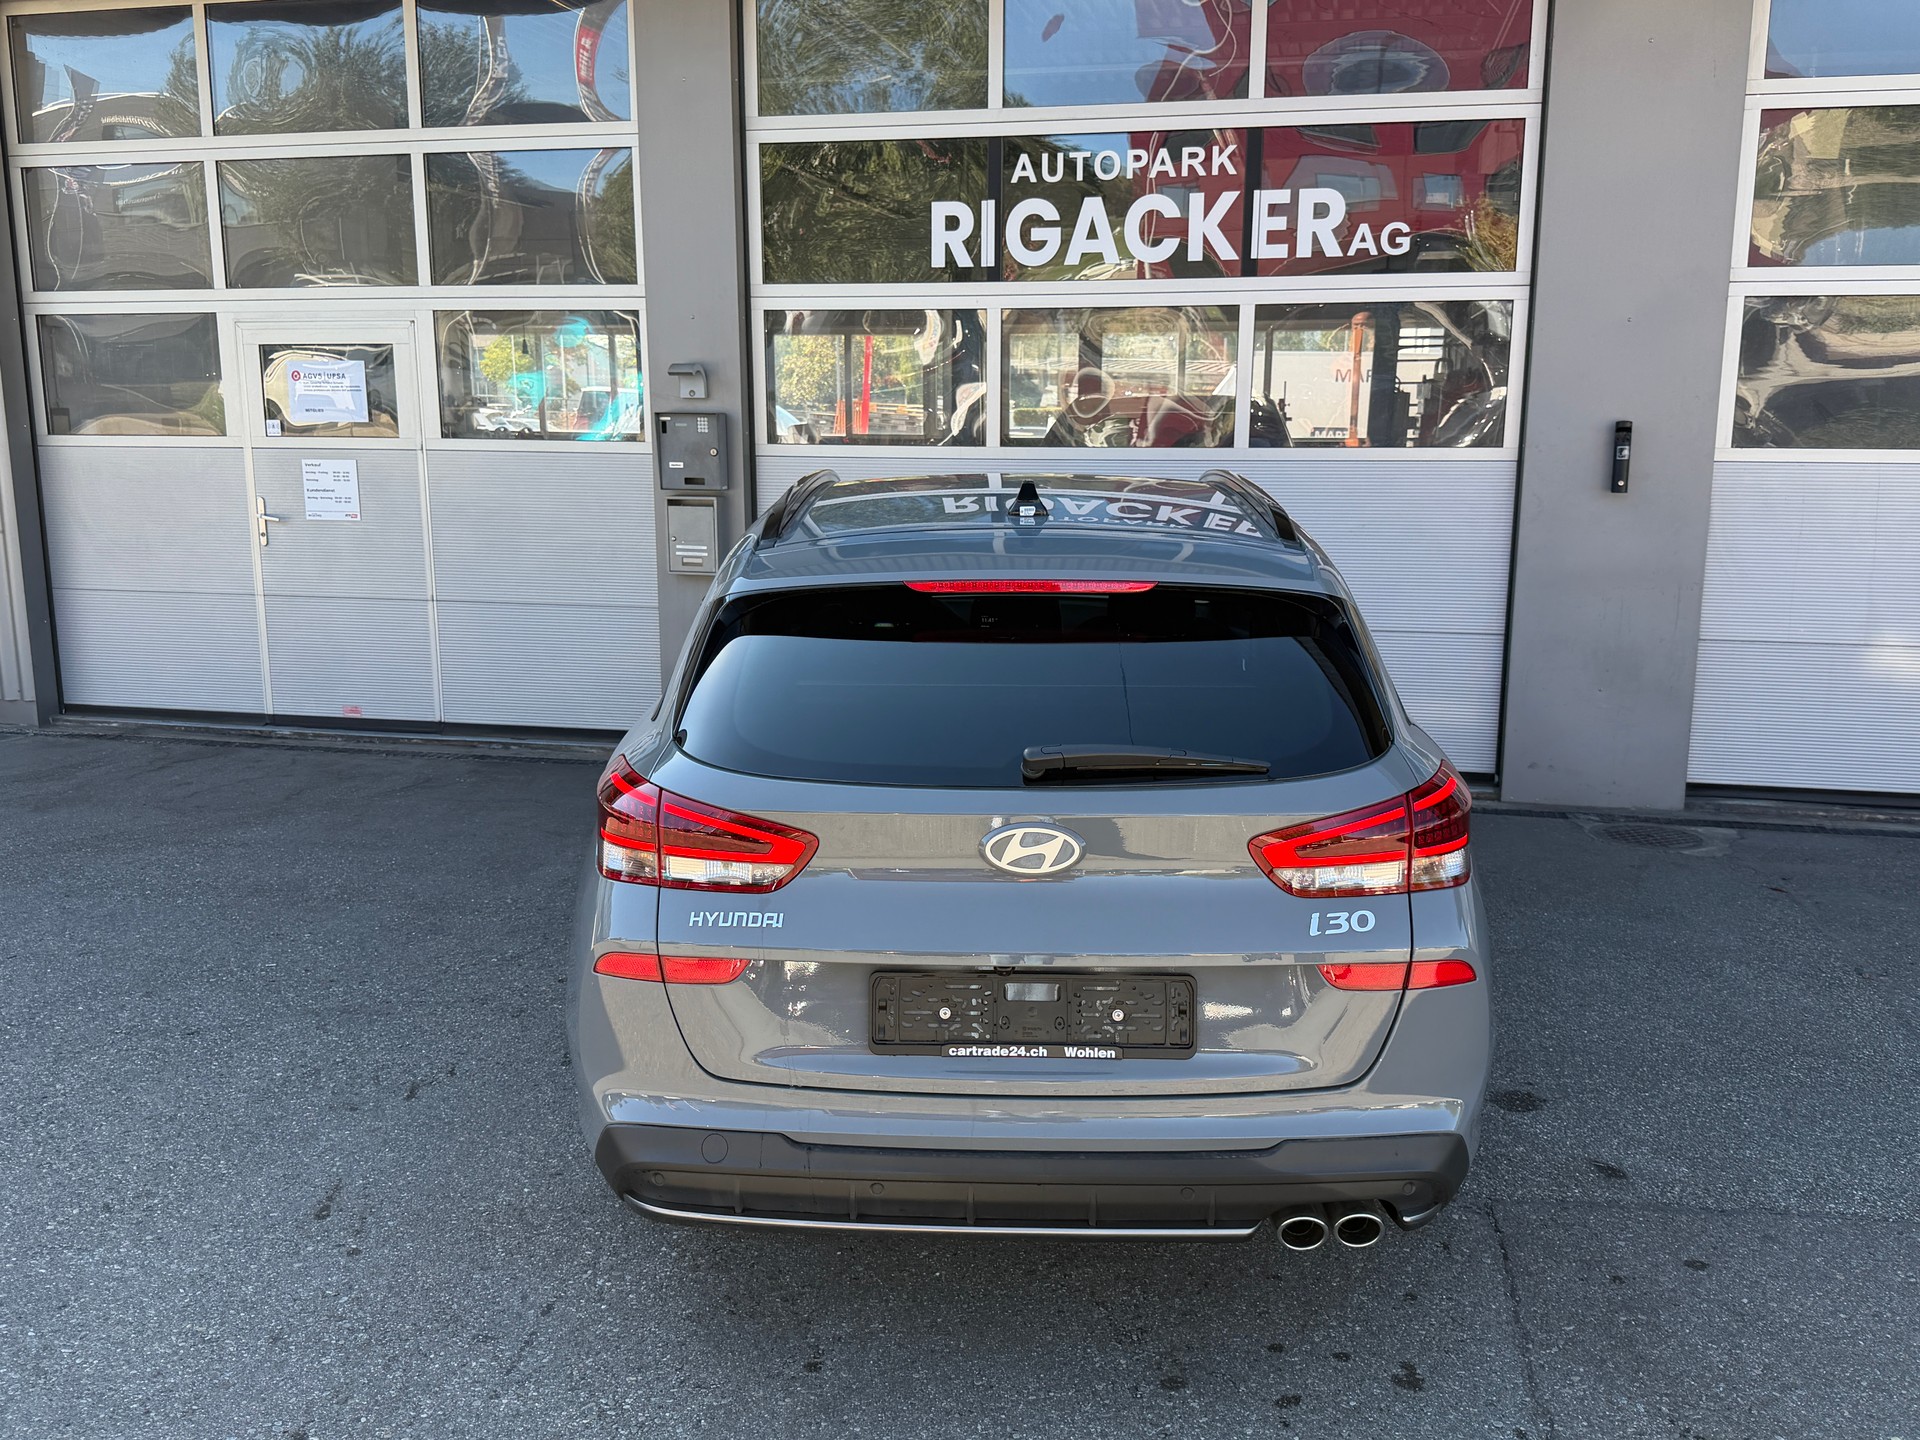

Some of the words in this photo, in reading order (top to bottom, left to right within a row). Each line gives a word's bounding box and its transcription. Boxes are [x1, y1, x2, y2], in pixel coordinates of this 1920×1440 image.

[1011, 145, 1238, 184] AUTOPARK
[931, 188, 1346, 268] RIGACKER
[1347, 221, 1411, 256] AG
[689, 911, 784, 928] HYUNDAI
[948, 1045, 1048, 1058] cartrade24.ch
[1064, 1046, 1116, 1059] Wohlen
